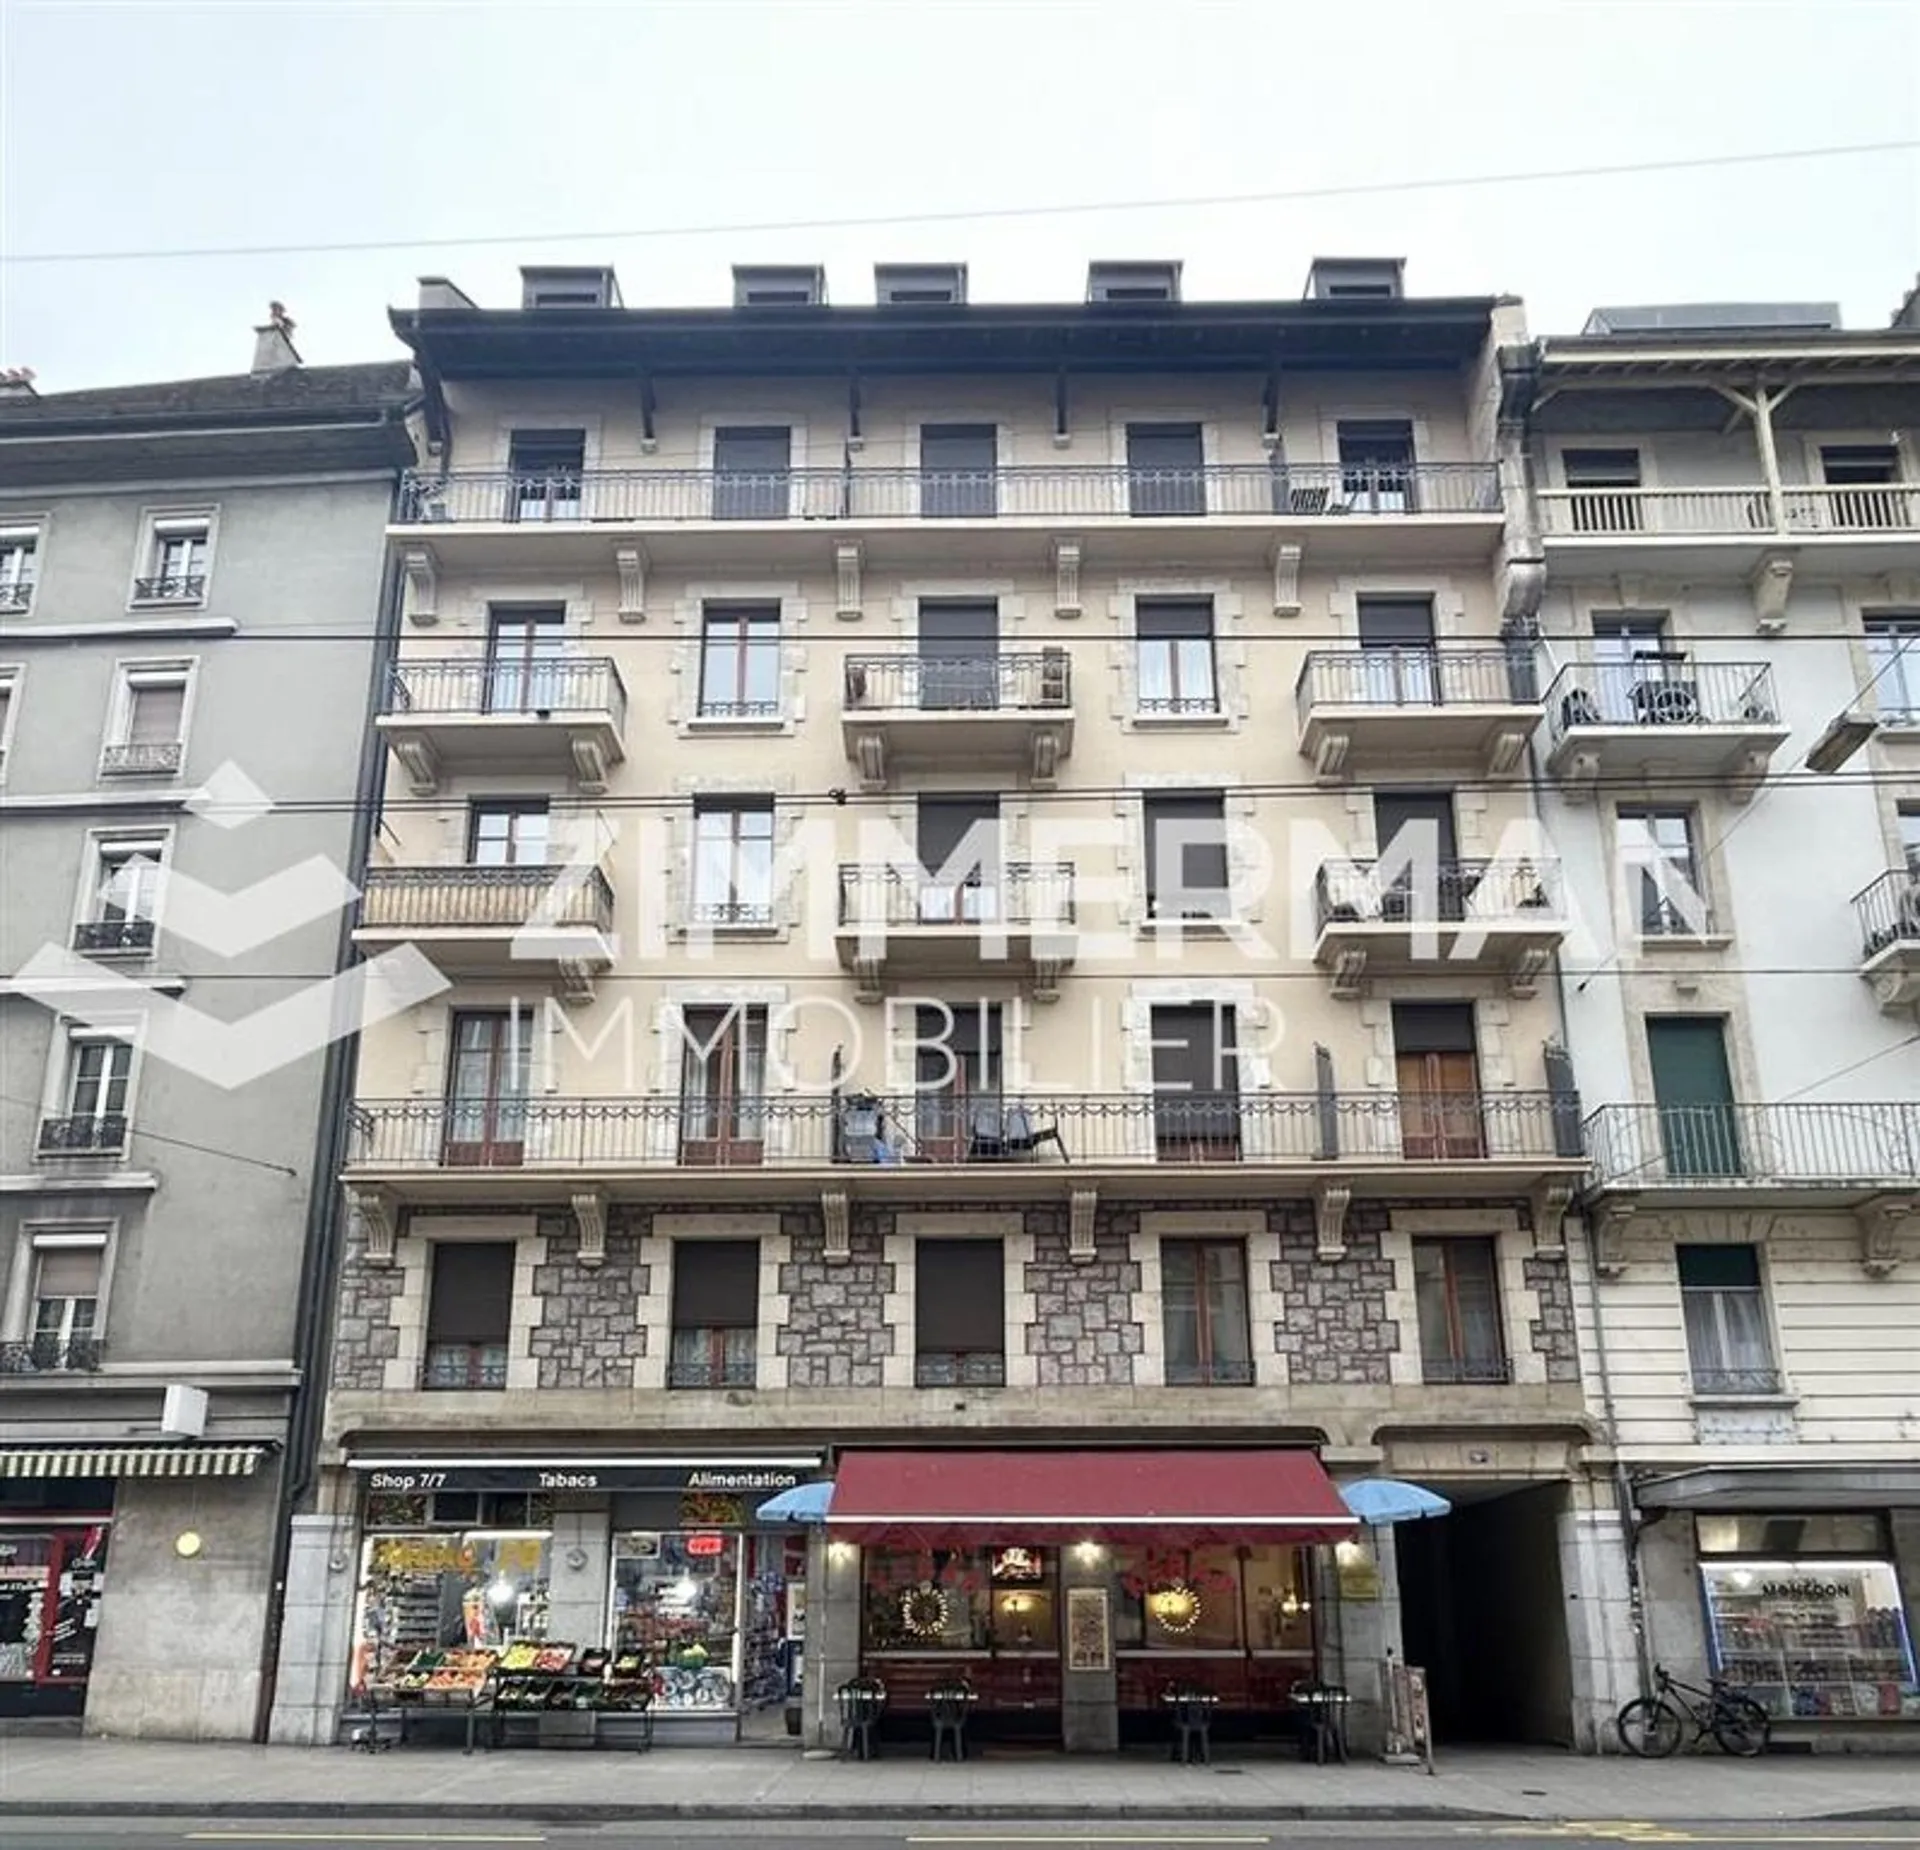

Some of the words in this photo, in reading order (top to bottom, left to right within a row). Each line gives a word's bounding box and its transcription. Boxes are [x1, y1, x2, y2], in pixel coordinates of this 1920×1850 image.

[370, 1472, 415, 1491] Shop
[419, 1472, 447, 1488] 7/7
[538, 1472, 598, 1488] Tabacs
[688, 1471, 797, 1488] Alimentation
